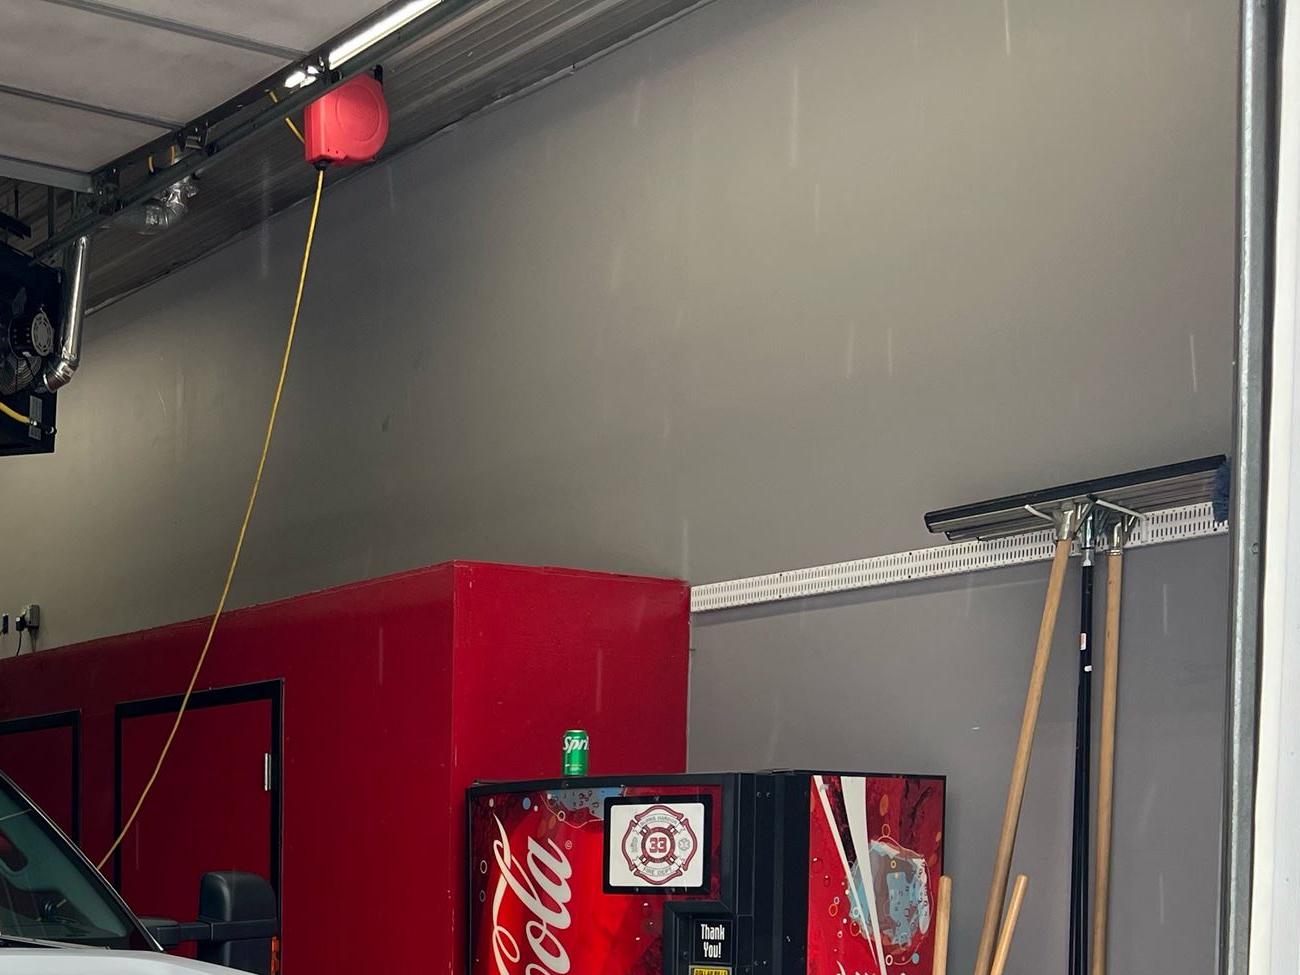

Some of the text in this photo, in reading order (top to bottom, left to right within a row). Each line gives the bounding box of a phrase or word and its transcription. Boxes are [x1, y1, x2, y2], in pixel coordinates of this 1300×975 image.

[563, 736, 589, 754] Spri
[649, 837, 667, 854] 33
[701, 923, 725, 941] Thank
[703, 941, 722, 959] You!
